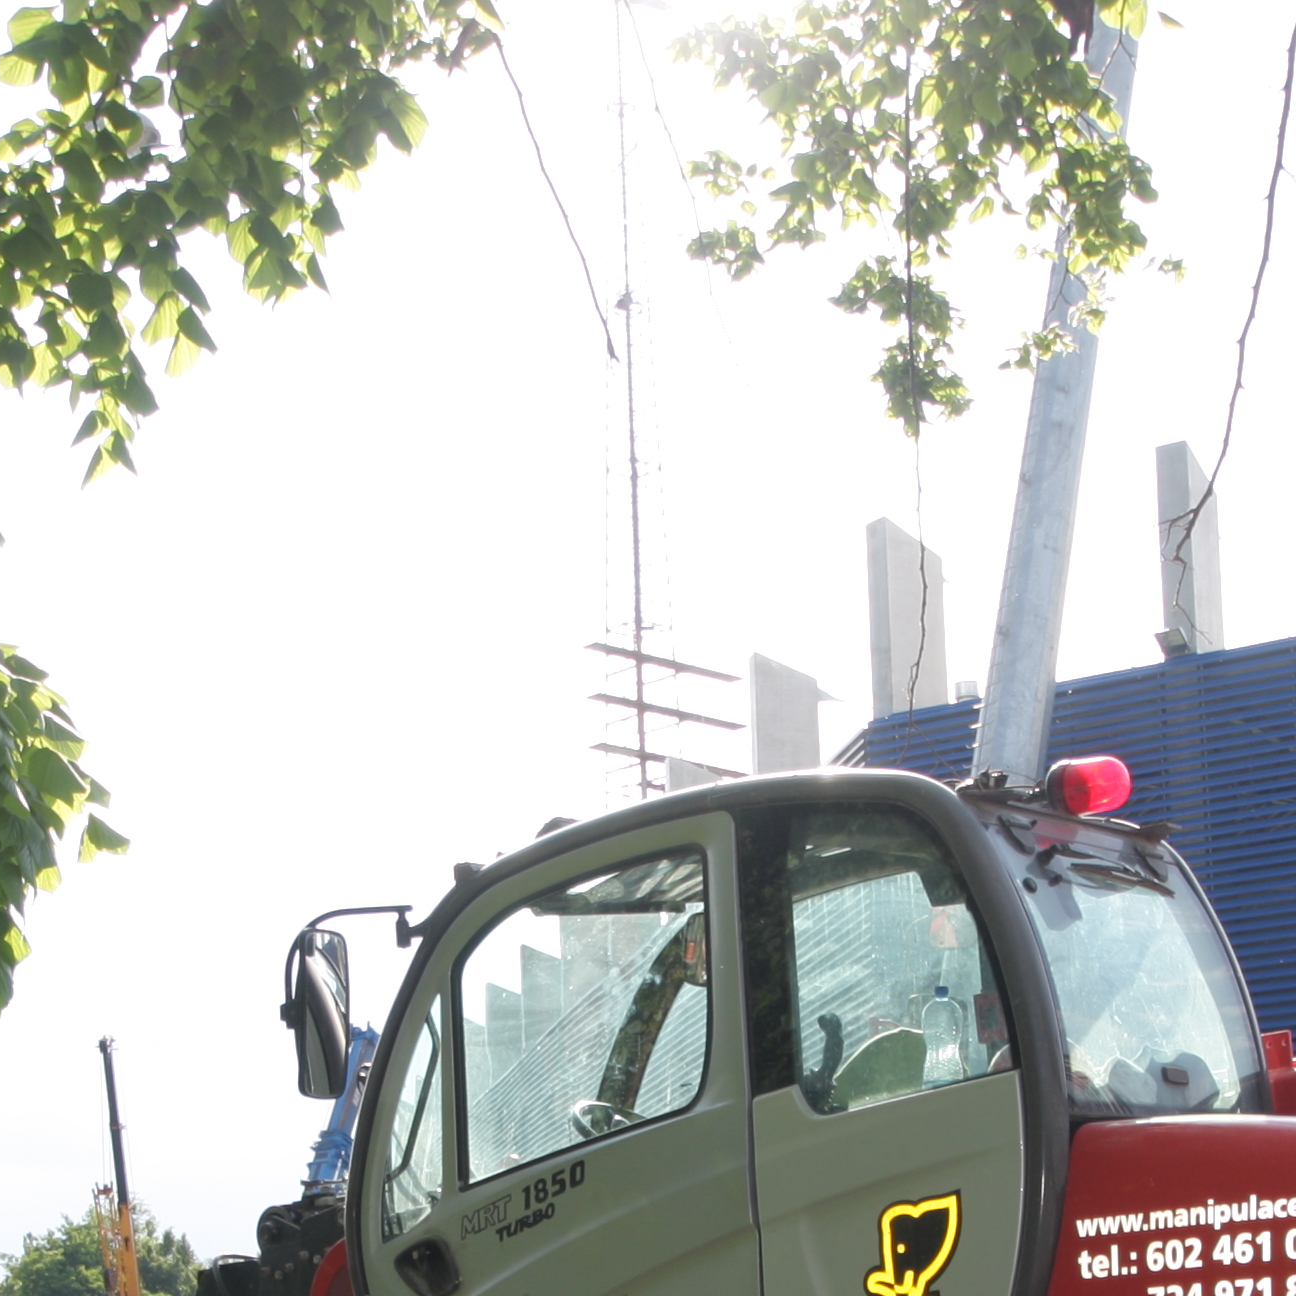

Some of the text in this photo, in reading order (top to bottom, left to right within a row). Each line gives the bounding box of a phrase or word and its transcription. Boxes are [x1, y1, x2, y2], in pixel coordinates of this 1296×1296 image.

[460, 1160, 586, 1240] MRT 1850
[495, 1203, 556, 1242] TURBO
[1077, 1244, 1138, 1279] tel.:
[1145, 1237, 1204, 1272] 602
[1212, 1231, 1272, 1265] 461
